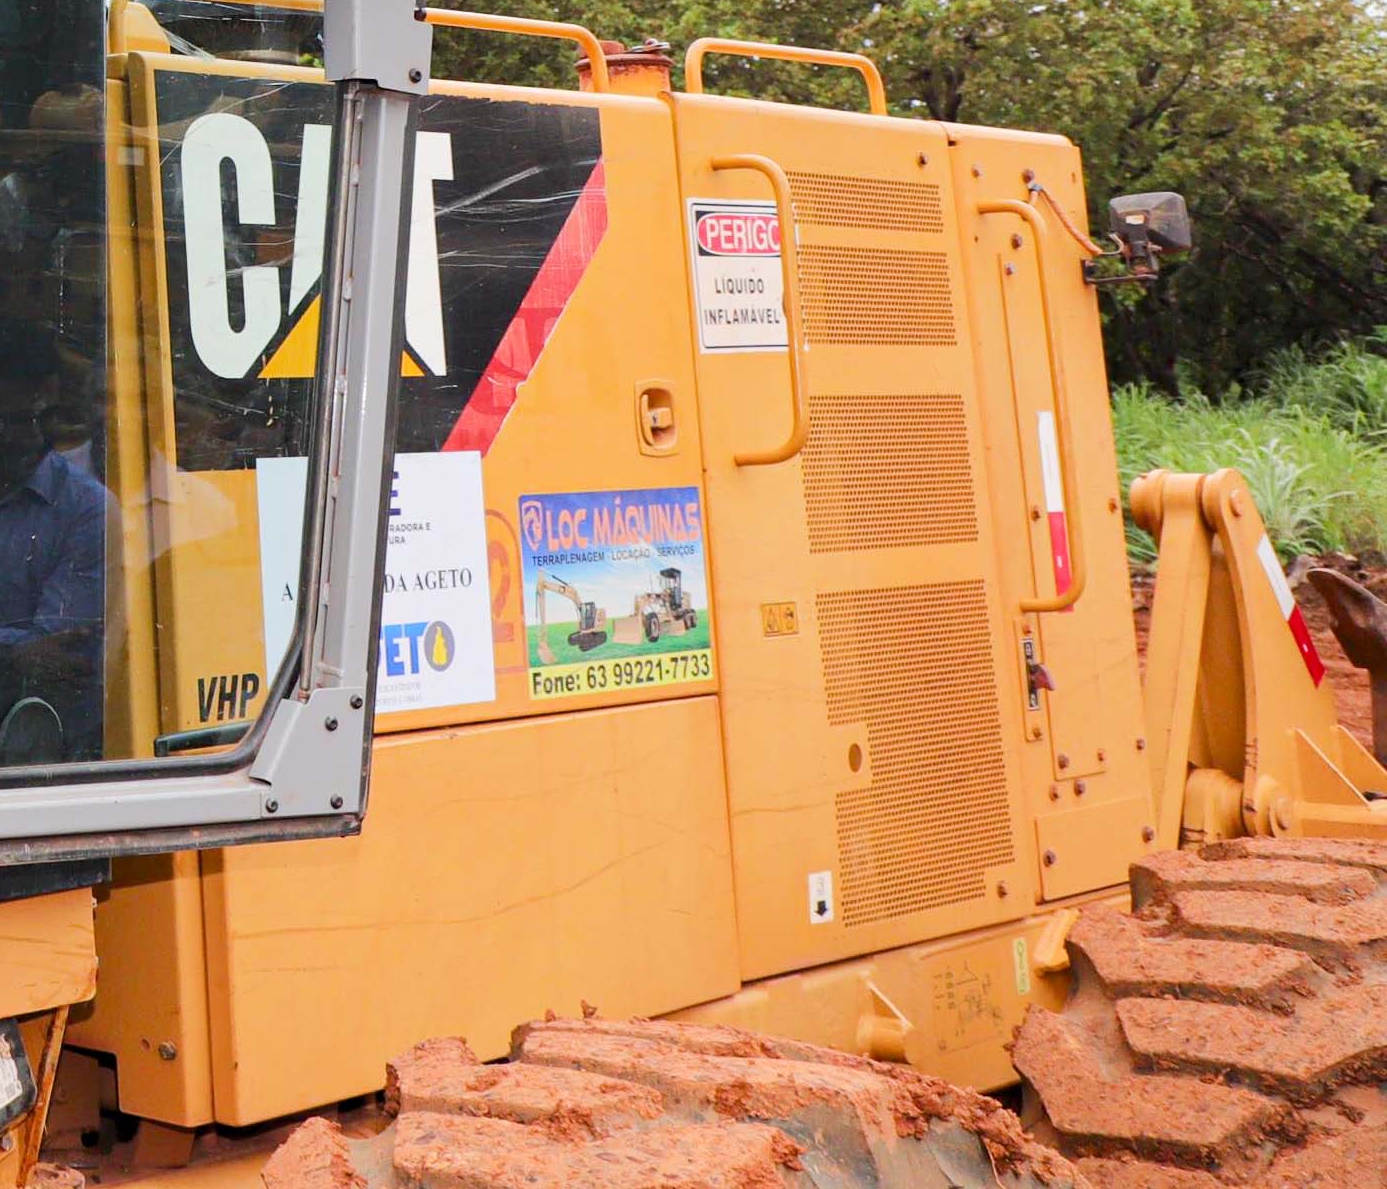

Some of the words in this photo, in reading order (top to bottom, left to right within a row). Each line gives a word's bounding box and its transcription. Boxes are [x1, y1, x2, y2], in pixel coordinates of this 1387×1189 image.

[714, 275, 765, 294] LÍQUIDO
[704, 305, 780, 325] INFLAMÁVEL
[546, 507, 588, 552] LOC
[592, 496, 700, 547] MÁQUINAS
[531, 551, 606, 567] TERRAPLENAGEM
[657, 544, 695, 558] SERVIÇOS
[414, 567, 472, 590] AGETO
[531, 671, 580, 696] Fone:
[586, 665, 607, 689] 63
[613, 653, 711, 687] 99221-7733
[197, 673, 260, 723] VHP
